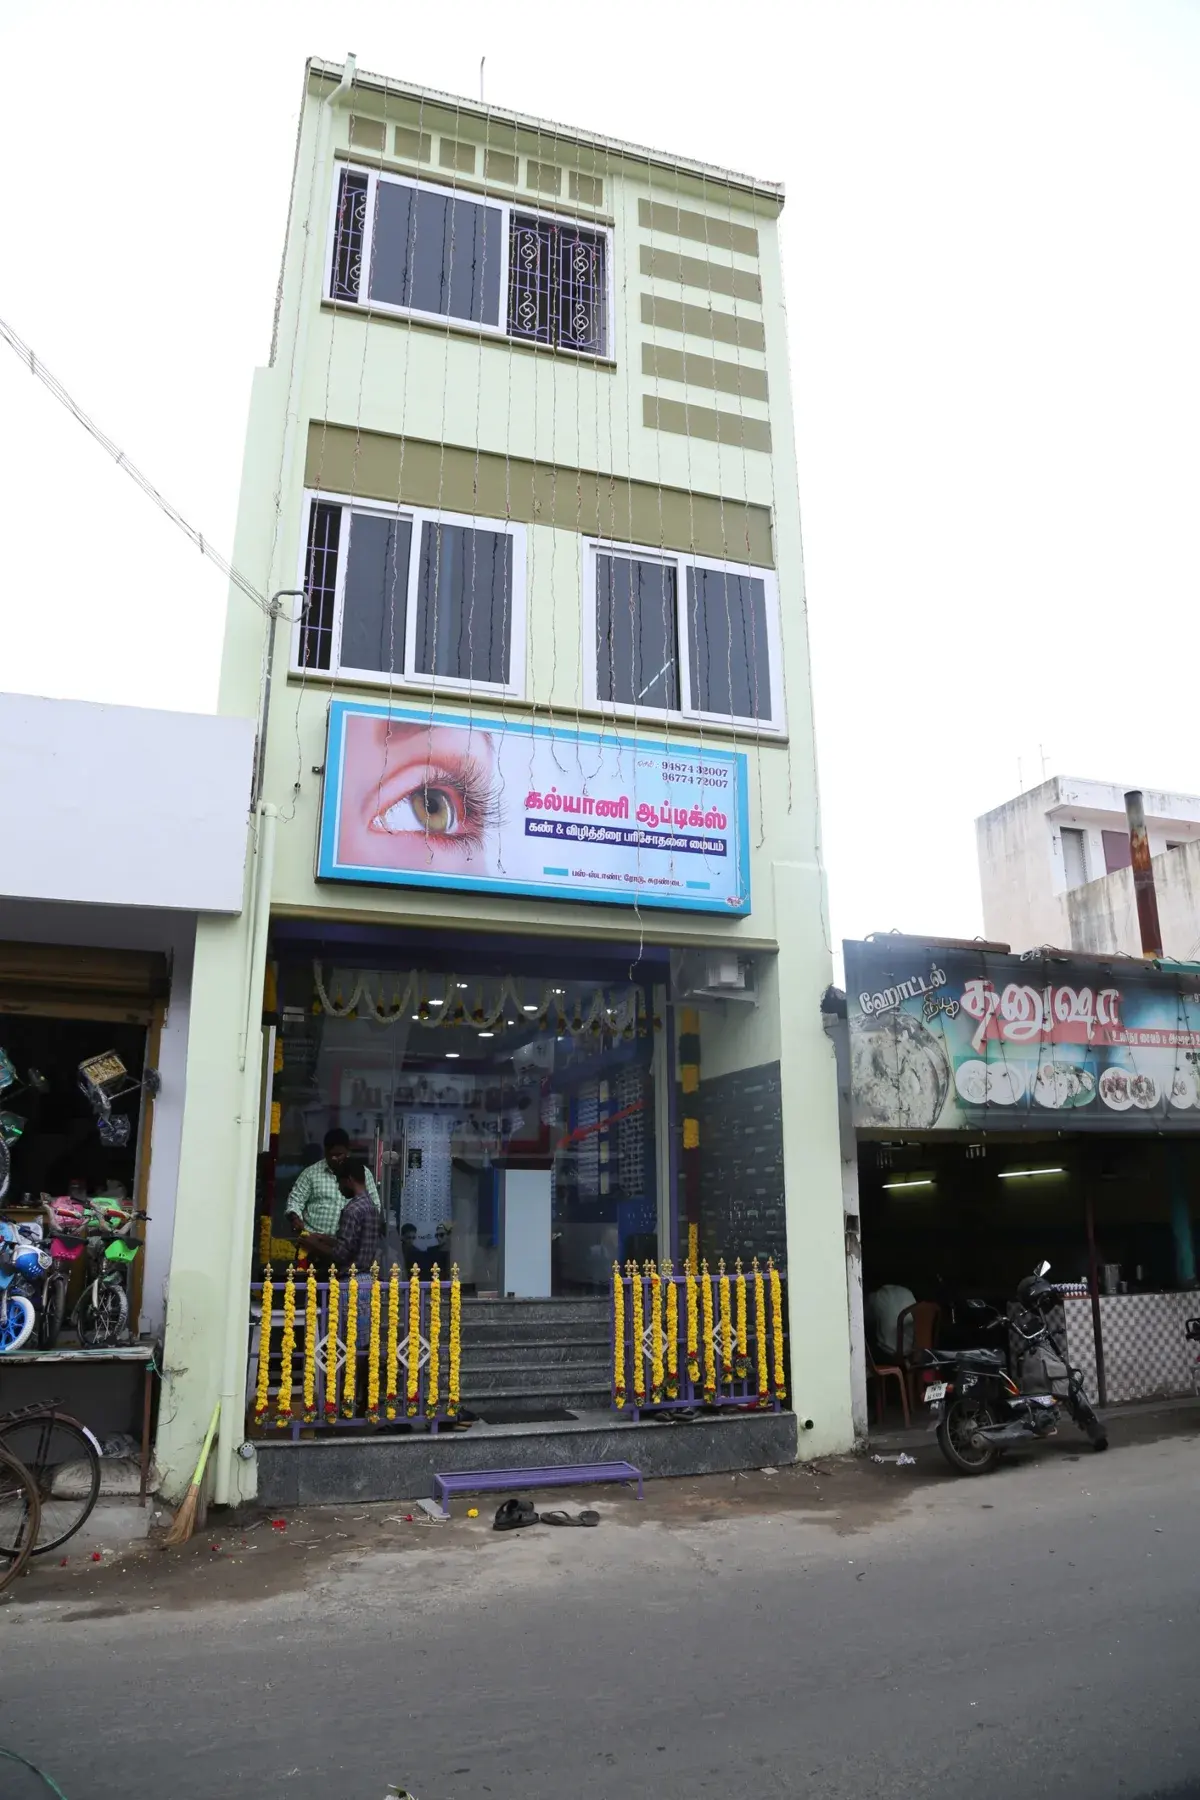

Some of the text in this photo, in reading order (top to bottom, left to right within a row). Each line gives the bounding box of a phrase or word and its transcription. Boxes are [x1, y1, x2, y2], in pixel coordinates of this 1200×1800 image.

[661, 761, 694, 774] 94874
[696, 765, 729, 778] 32007
[661, 772, 729, 789] 96774 72007
[525, 786, 728, 831] கல்யாணி ஆப்டிக்ஸ்
[528, 821, 725, 852] கண் & விழித்திரை பரிசோதனை மையம்
[859, 962, 947, 1019] ஹோட்டல்
[960, 979, 1120, 1052] தனுஷா
